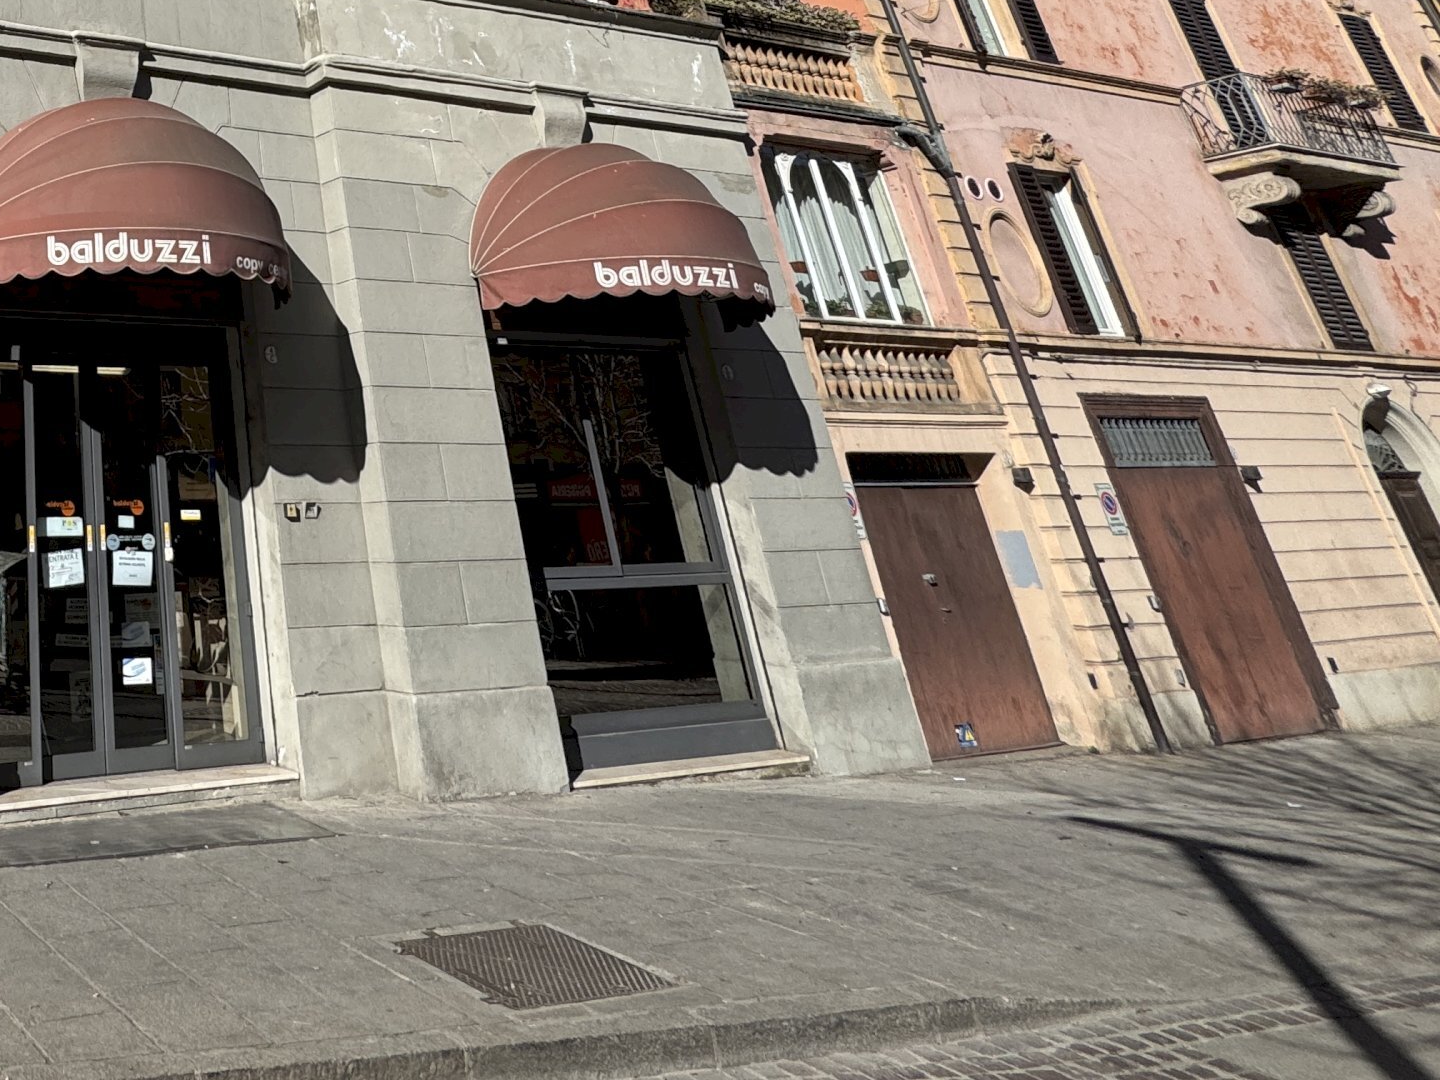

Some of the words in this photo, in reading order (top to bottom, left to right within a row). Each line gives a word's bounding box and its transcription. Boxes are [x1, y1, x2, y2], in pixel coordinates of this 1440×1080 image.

[47, 232, 211, 266] balduzzi
[236, 255, 264, 274] copy
[593, 259, 739, 289] balduzzi
